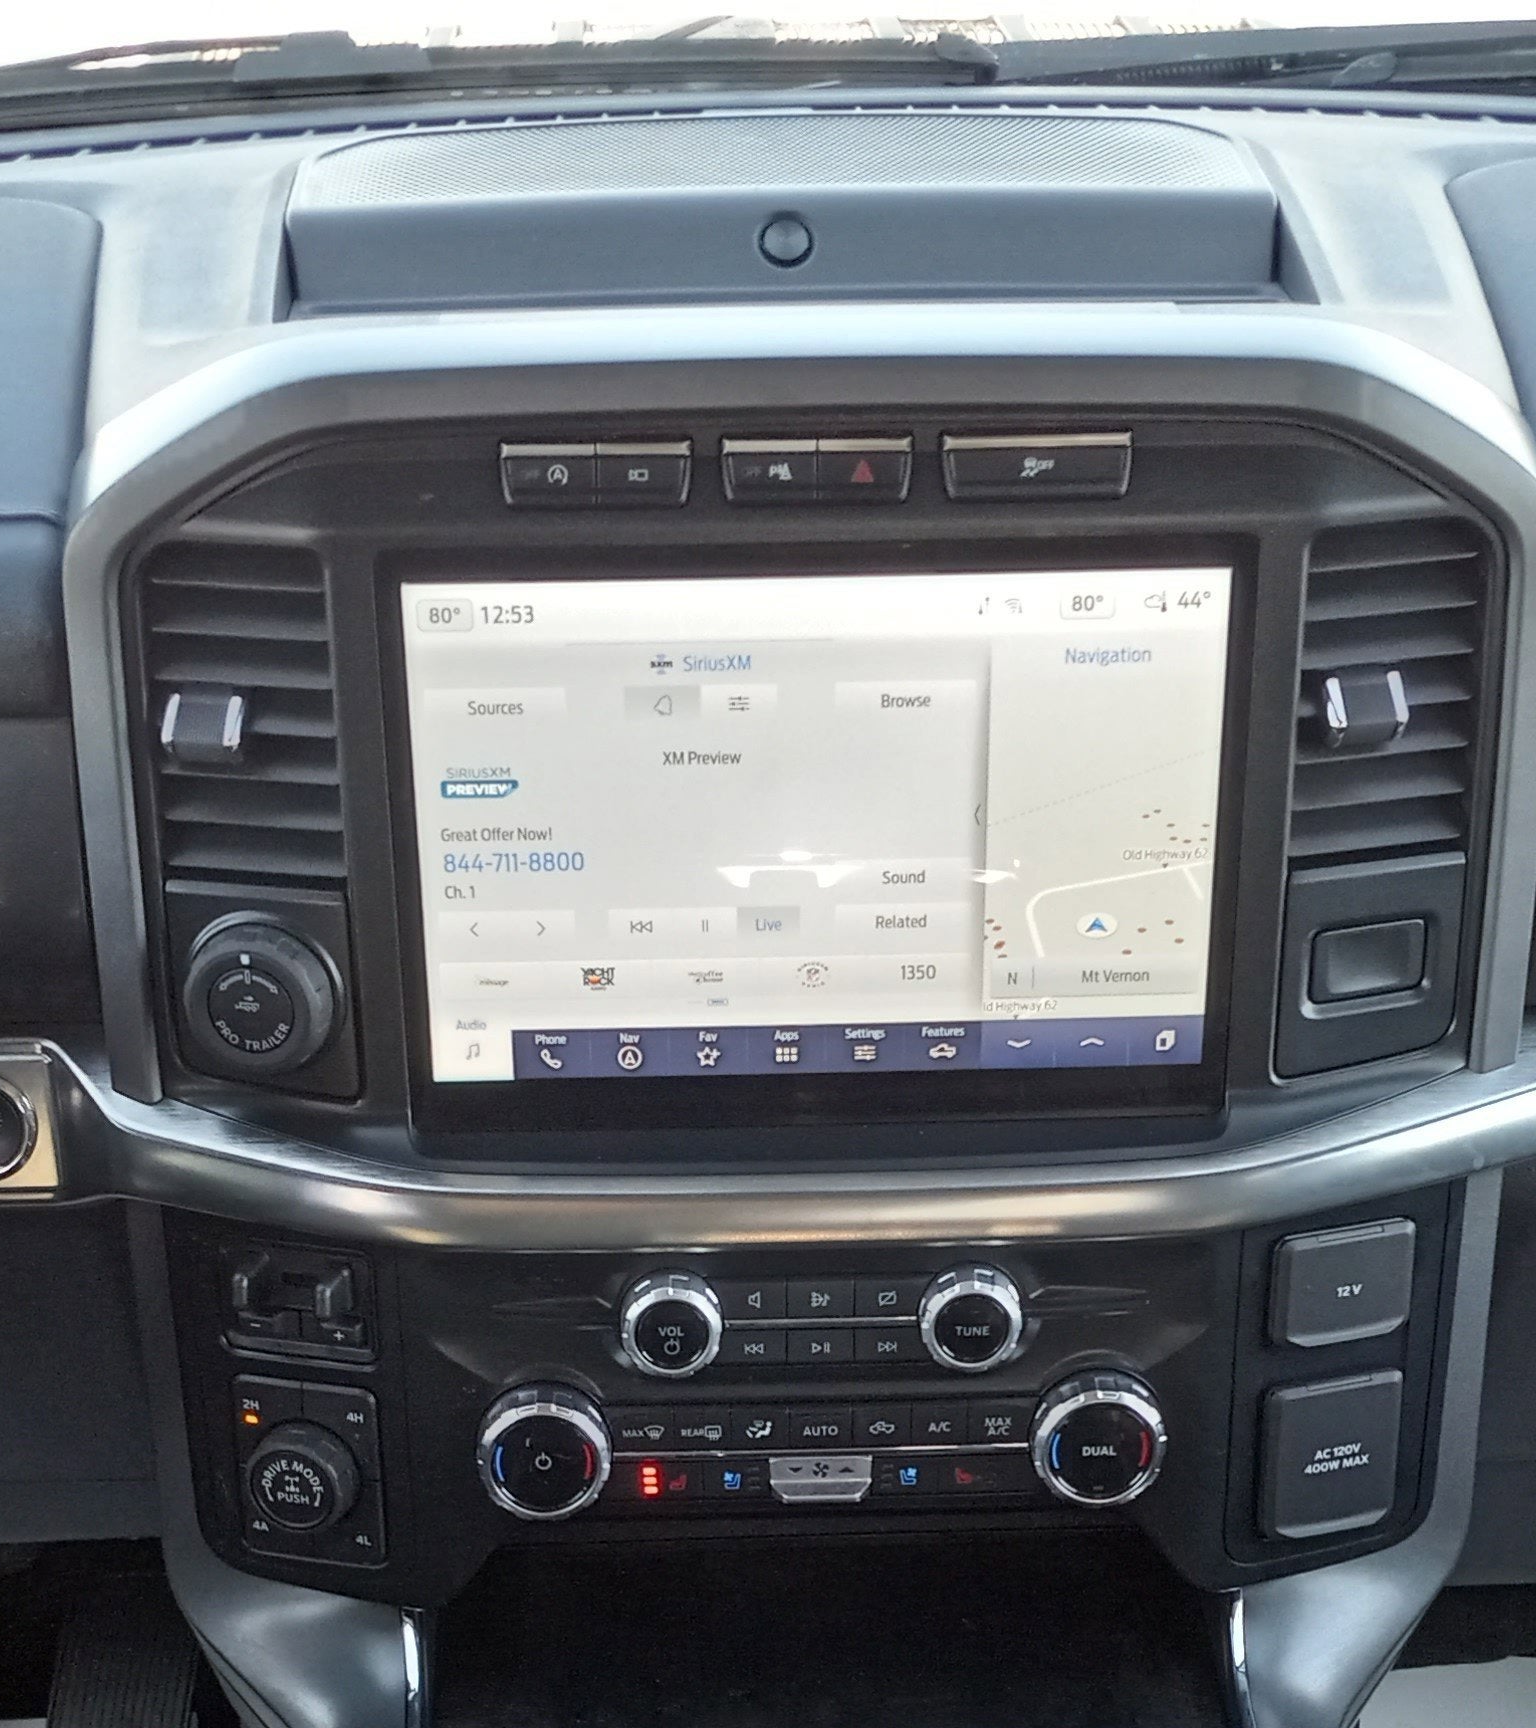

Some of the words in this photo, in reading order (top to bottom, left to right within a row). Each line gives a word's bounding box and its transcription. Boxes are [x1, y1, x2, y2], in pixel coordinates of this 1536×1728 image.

[1071, 594, 1104, 612] 80°
[1177, 591, 1212, 608] 44°
[429, 607, 461, 625] 80°
[481, 605, 535, 625] 12:53
[683, 655, 751, 672] SiriusXM
[1064, 647, 1152, 666] Navigation
[880, 694, 932, 708] Browse
[467, 701, 524, 716] Sources
[662, 752, 684, 765] XM
[688, 752, 742, 767] Preview
[446, 782, 513, 797] PREVIEW
[440, 828, 477, 843] Great
[481, 828, 515, 843] Offer
[517, 827, 553, 842] Now!
[443, 851, 585, 874] 844-711-8800
[1122, 849, 1142, 861] Old
[1144, 848, 1193, 863] Highway
[882, 870, 926, 885] Sound
[445, 886, 467, 900] Ch.
[469, 886, 476, 899] 1
[756, 917, 782, 932] Live
[875, 914, 927, 930] Related
[901, 965, 937, 981] 1350
[1007, 971, 1018, 985] N
[1081, 970, 1100, 984] Mt
[1102, 969, 1151, 983] Vernon
[995, 1000, 1043, 1014] Highway
[455, 1018, 487, 1031] Audio
[215, 1020, 239, 1045] PRO
[244, 1022, 290, 1051] TRAILER
[620, 1032, 640, 1044] Nav
[699, 1031, 718, 1043] Fav
[774, 1030, 800, 1044] Apps
[844, 1026, 886, 1041] Settings
[922, 1025, 965, 1039] Features
[535, 1034, 567, 1047] Phone
[658, 1326, 684, 1338] VOL
[955, 1325, 990, 1337] TUNE
[242, 1398, 260, 1411] 2H
[346, 1412, 364, 1424] 4H
[985, 1416, 1012, 1427] MAX
[622, 1428, 644, 1438] MAX
[681, 1427, 704, 1438] REAR
[803, 1425, 838, 1437] AUTO
[928, 1420, 951, 1434] A/C
[987, 1426, 1010, 1437] A/C
[1082, 1445, 1117, 1458] DUAL
[1314, 1446, 1331, 1461] AC
[1332, 1443, 1362, 1458] 120V
[1304, 1459, 1340, 1475] 400W
[1342, 1453, 1369, 1468] MAX
[261, 1459, 290, 1488] DRIVE
[291, 1460, 324, 1494] MODE
[277, 1491, 310, 1506] PUSH
[253, 1519, 269, 1532] 4A
[355, 1534, 372, 1546] 4L
